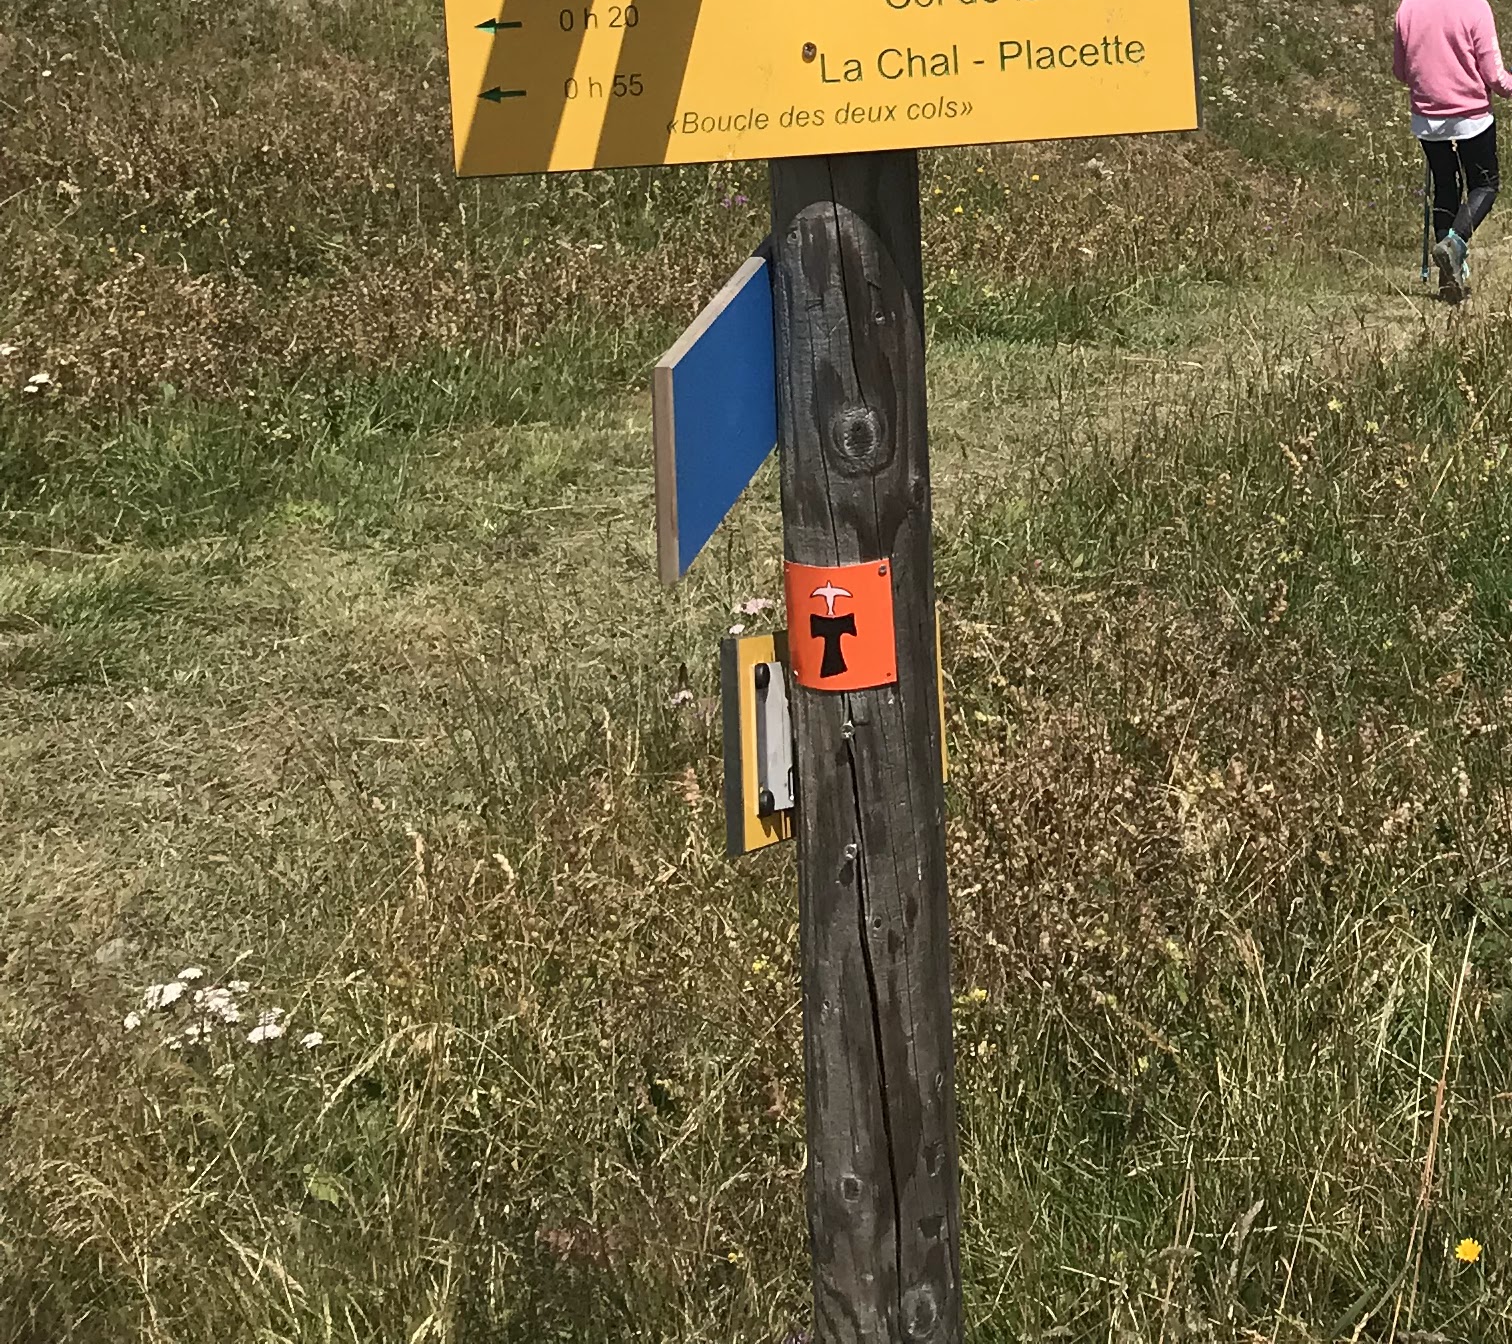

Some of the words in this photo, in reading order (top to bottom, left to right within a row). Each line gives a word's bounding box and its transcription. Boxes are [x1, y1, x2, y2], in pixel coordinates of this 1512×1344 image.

[559, 9, 574, 32] 0
[583, 6, 598, 30] h
[608, 4, 640, 29] 20
[820, 53, 864, 84] La
[877, 44, 959, 80] Chal
[999, 35, 1146, 73] Placette
[564, 77, 579, 100] 0
[588, 75, 603, 99] h
[611, 73, 644, 98] 55
[666, 108, 770, 135] «Boucle
[779, 105, 826, 130] des
[835, 102, 898, 127] deux
[907, 96, 974, 122] cols»
